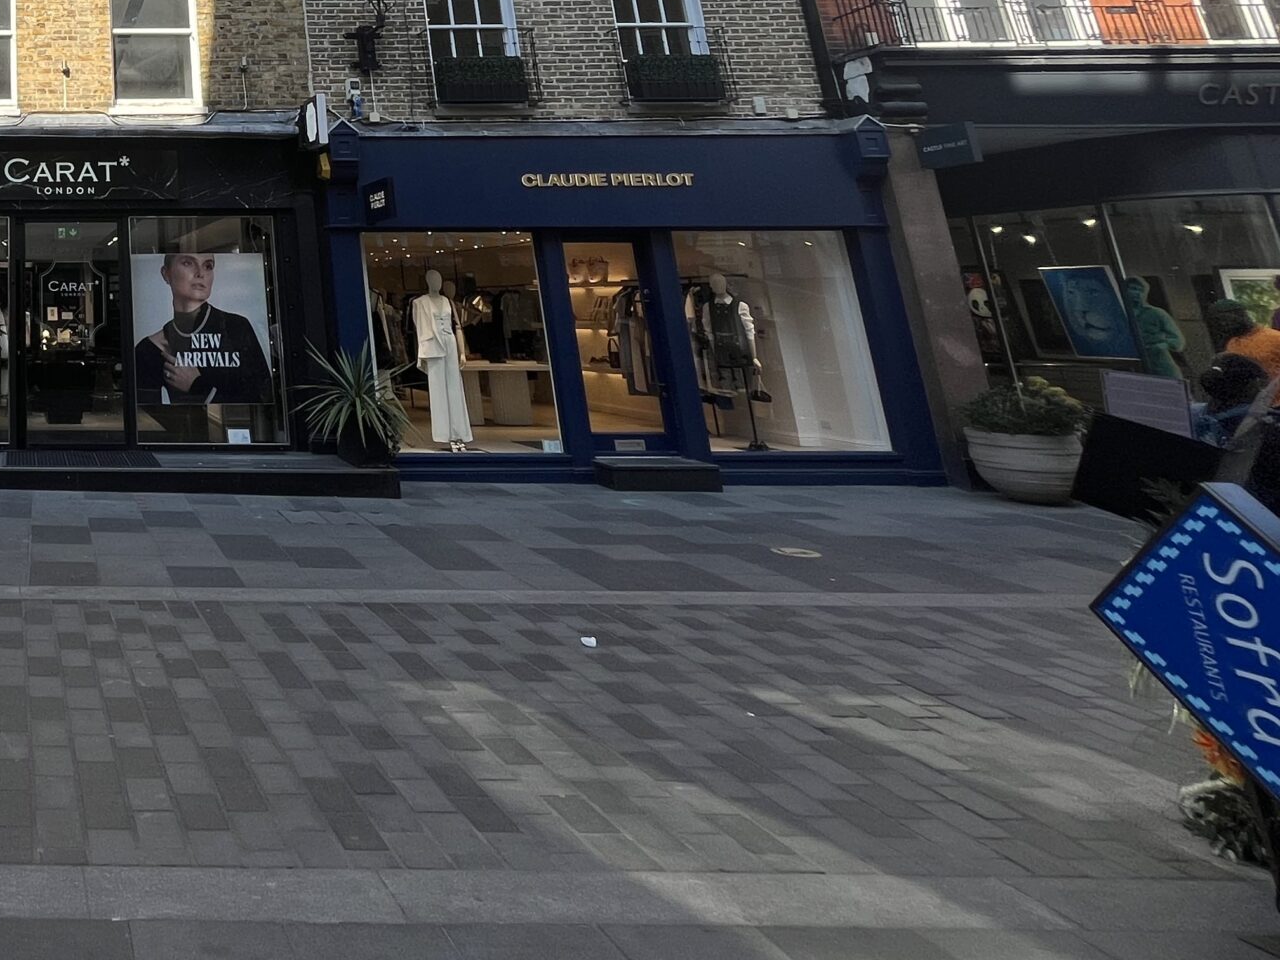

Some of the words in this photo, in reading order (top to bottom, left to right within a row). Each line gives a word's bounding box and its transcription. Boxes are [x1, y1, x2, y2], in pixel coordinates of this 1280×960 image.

[1198, 82, 1280, 105] CAST
[521, 173, 609, 187] CLAUDIE
[610, 172, 694, 186] PIERLOT
[36, 186, 95, 195] LONDON
[191, 333, 222, 349] NEW
[174, 351, 241, 368] ARRIVALS
[1177, 572, 1229, 702] RESTAURANTS
